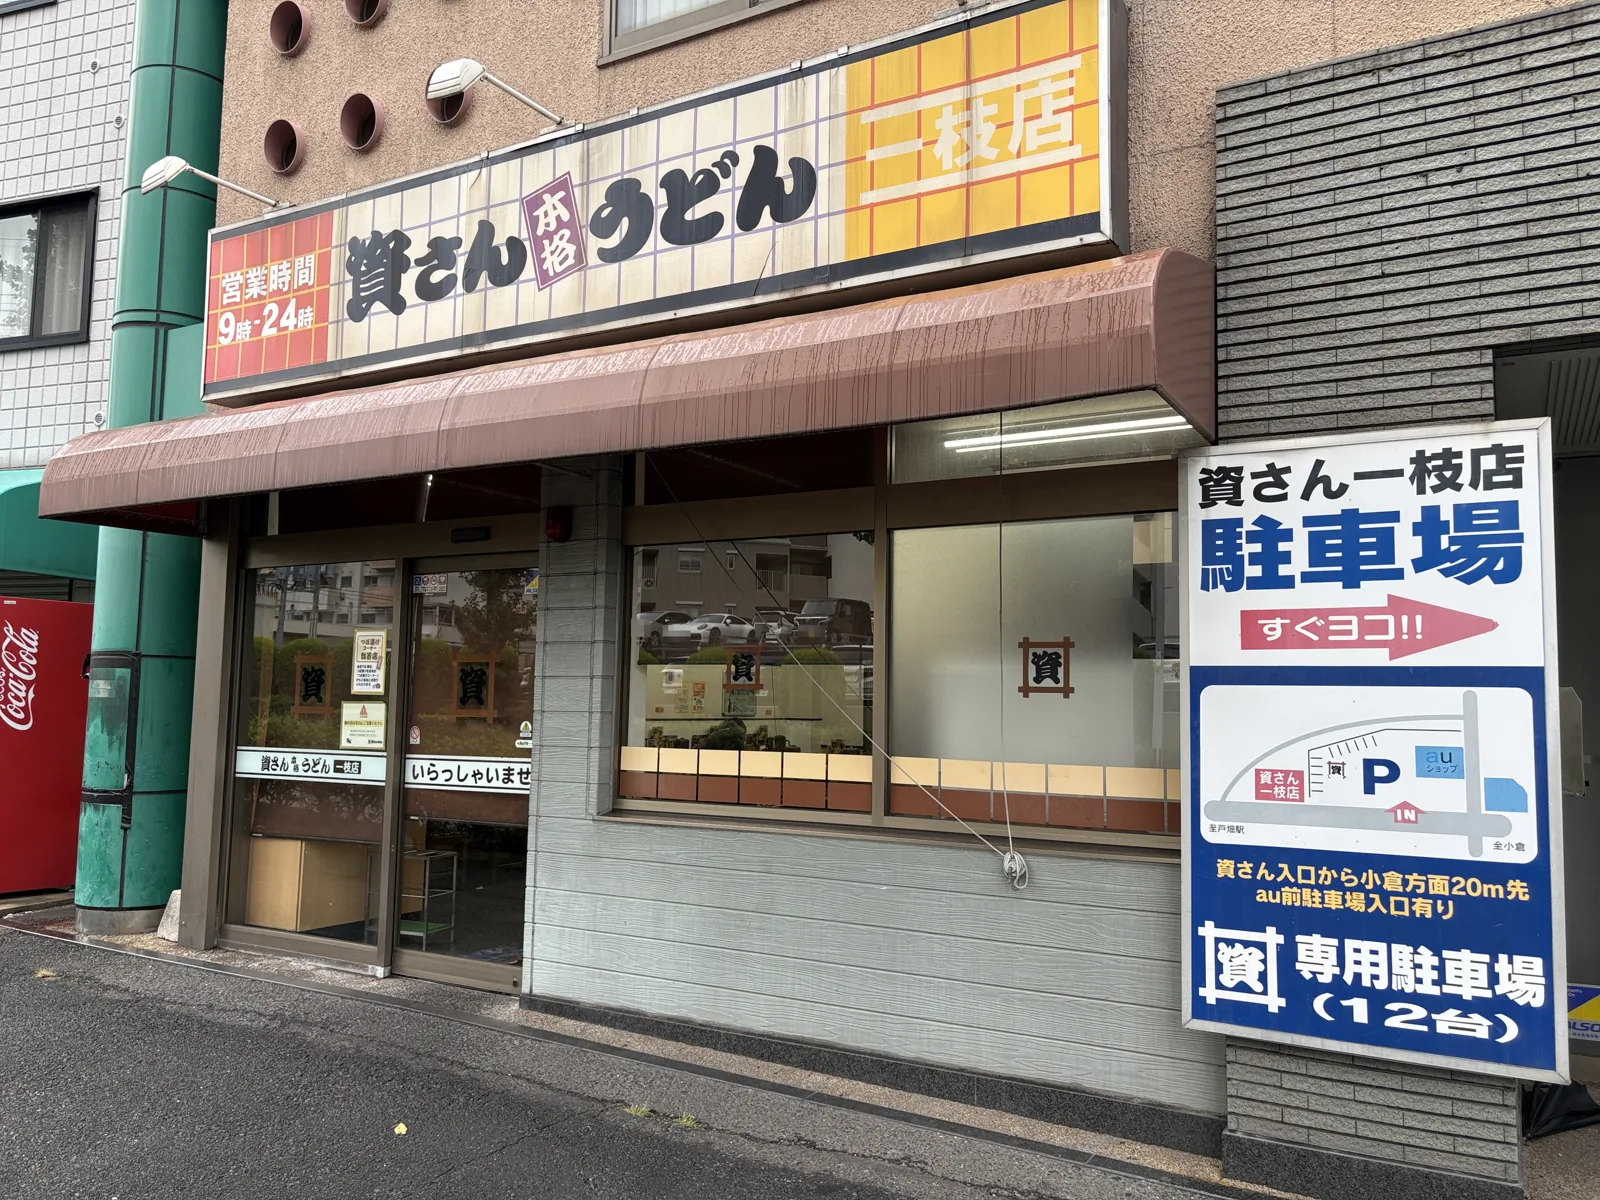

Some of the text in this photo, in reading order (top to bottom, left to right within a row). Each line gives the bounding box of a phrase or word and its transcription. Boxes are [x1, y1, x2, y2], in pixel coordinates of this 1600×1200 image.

[865, 76, 1076, 171] 一枝店
[346, 144, 817, 323] 資さん 本格 うどん
[221, 253, 315, 307] 営業時間
[1198, 443, 1525, 510] 資さん一枝店
[1200, 500, 1525, 593] 駐車場
[1257, 614, 1424, 642] すぐヨコ!!
[0, 619, 40, 731] Coca-Cola
[302, 666, 325, 703] 資
[732, 653, 754, 683] 資
[1031, 650, 1063, 685] 資
[458, 666, 487, 706] 資
[261, 755, 289, 773] 資さん
[301, 757, 331, 775] うどん
[334, 761, 361, 774] 一枝店
[411, 762, 531, 786] いらっしゃいませ
[1426, 751, 1454, 764] au
[1426, 764, 1458, 774] ショップ
[1259, 771, 1300, 786] 資さん
[1259, 785, 1300, 800] 一枝店
[1362, 757, 1401, 795] P
[1208, 824, 1245, 835] 至戸畑駅
[1396, 809, 1416, 821] IN
[1216, 858, 1530, 902] 資さん入口から小倉方面20m先
[1255, 886, 1455, 920] au前駐車場入口有り
[1295, 933, 1547, 1008] 専用駐車場
[1312, 992, 1520, 1044] (12台)
